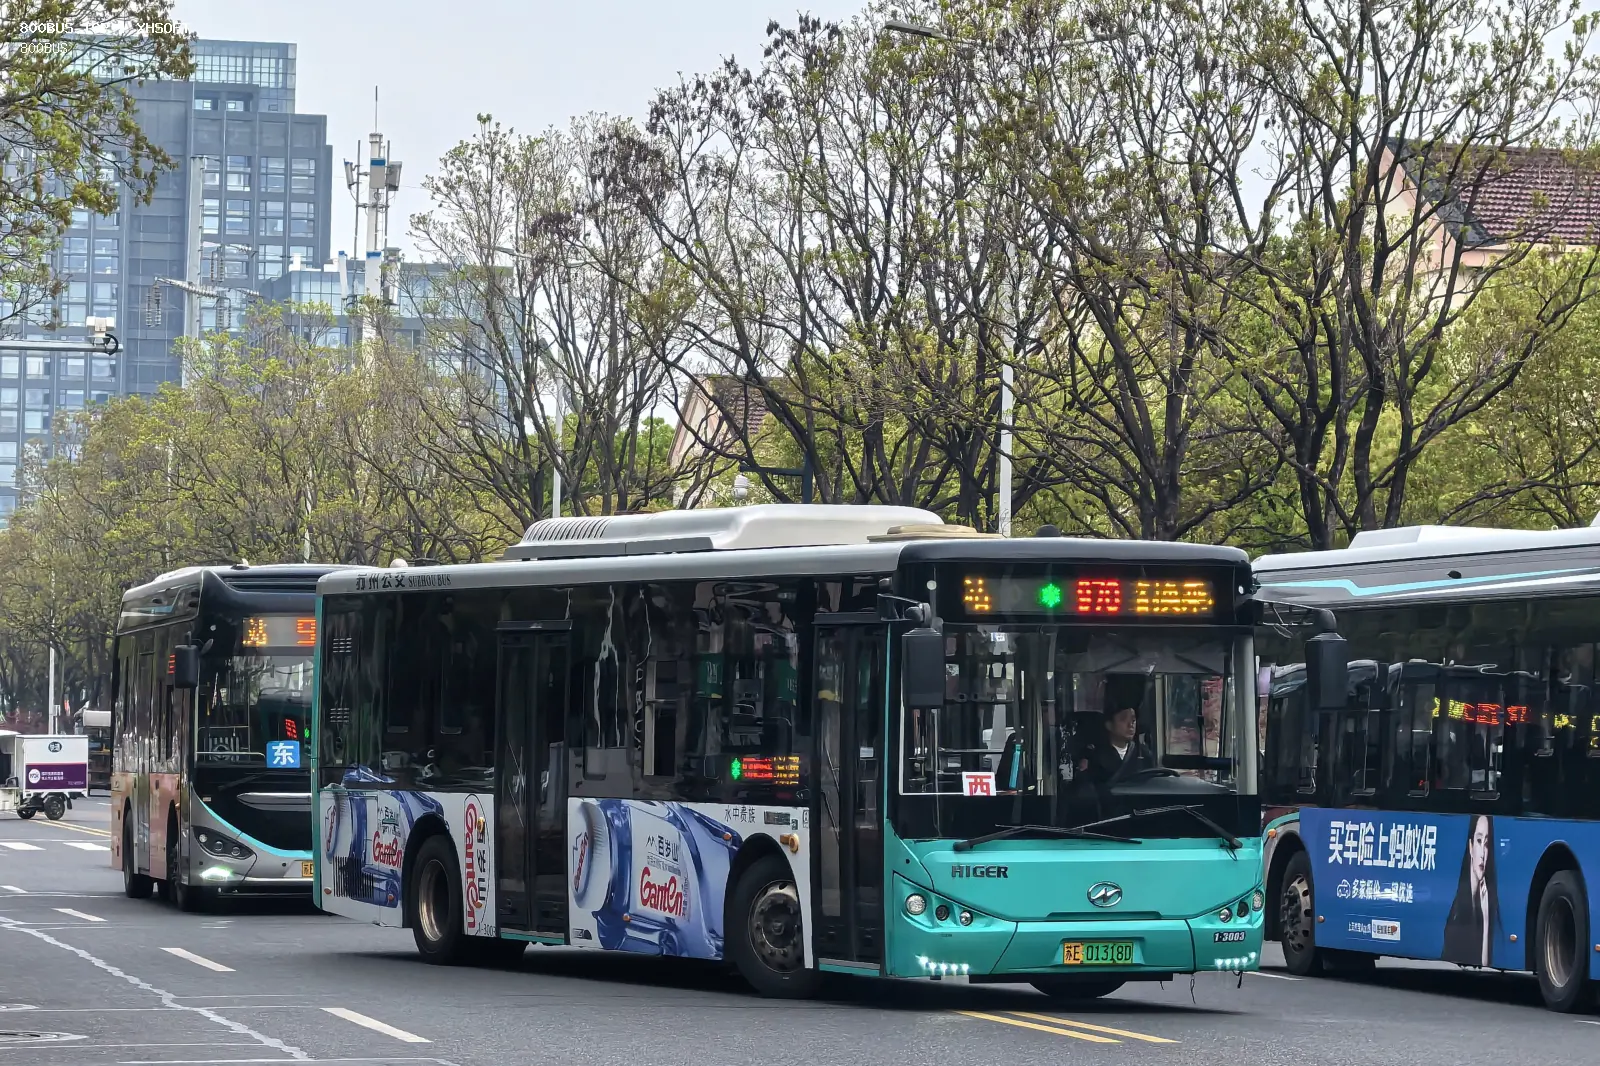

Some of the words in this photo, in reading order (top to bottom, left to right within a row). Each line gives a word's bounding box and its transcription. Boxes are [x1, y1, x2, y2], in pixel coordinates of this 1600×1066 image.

[355, 571, 406, 591] 苏州公交
[408, 574, 436, 587] SUZHOU
[437, 573, 452, 586] BUS
[272, 742, 294, 765] 东
[965, 774, 992, 797] 西
[724, 804, 756, 824] 水中贵族
[657, 834, 679, 863] 百岁山
[1328, 820, 1437, 871] 买车险上蚂蚁保
[465, 803, 480, 929] Ganten
[951, 864, 1009, 879] HIGER
[640, 866, 684, 917] Ganten
